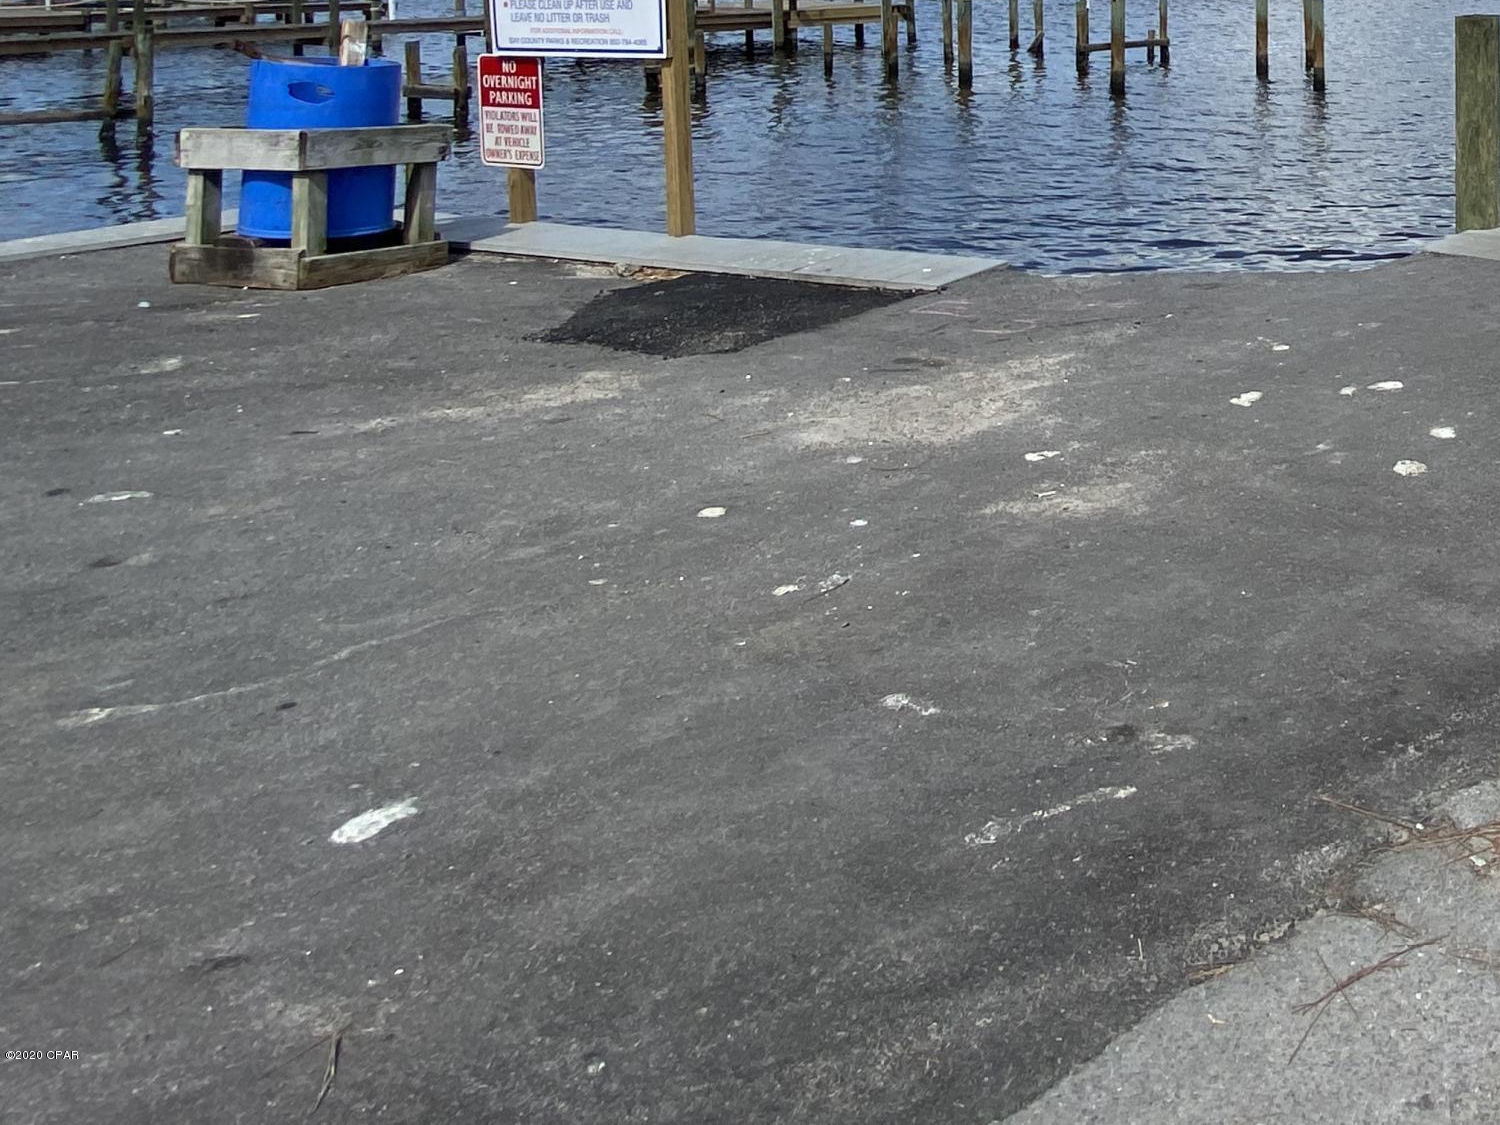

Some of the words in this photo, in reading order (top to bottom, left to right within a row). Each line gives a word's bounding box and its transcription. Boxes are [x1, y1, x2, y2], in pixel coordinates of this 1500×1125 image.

[510, 1, 537, 10] PLEASE
[538, 1, 562, 10] CLEAN
[563, 1, 574, 10] UP
[575, 0, 599, 10] AFTER
[600, 0, 615, 10] USE
[617, 0, 633, 9] AND
[511, 14, 533, 23] LEAVE
[535, 13, 545, 23] NO
[547, 13, 571, 23] LITTER
[572, 13, 583, 22] OR
[585, 13, 610, 22] TRASH
[502, 61, 516, 73] NO
[483, 75, 537, 89] OVERNIGHT
[489, 91, 532, 105] PARKING
[485, 111, 520, 121] VIOLATORS
[521, 112, 537, 122] WILL
[486, 123, 494, 133] BE
[498, 124, 519, 134] TOWED
[521, 125, 537, 135] AWAY
[495, 137, 503, 146] AT
[504, 137, 530, 148] VEHICLE
[486, 149, 512, 159] OWNER'S
[515, 150, 540, 161] EXPENSE
